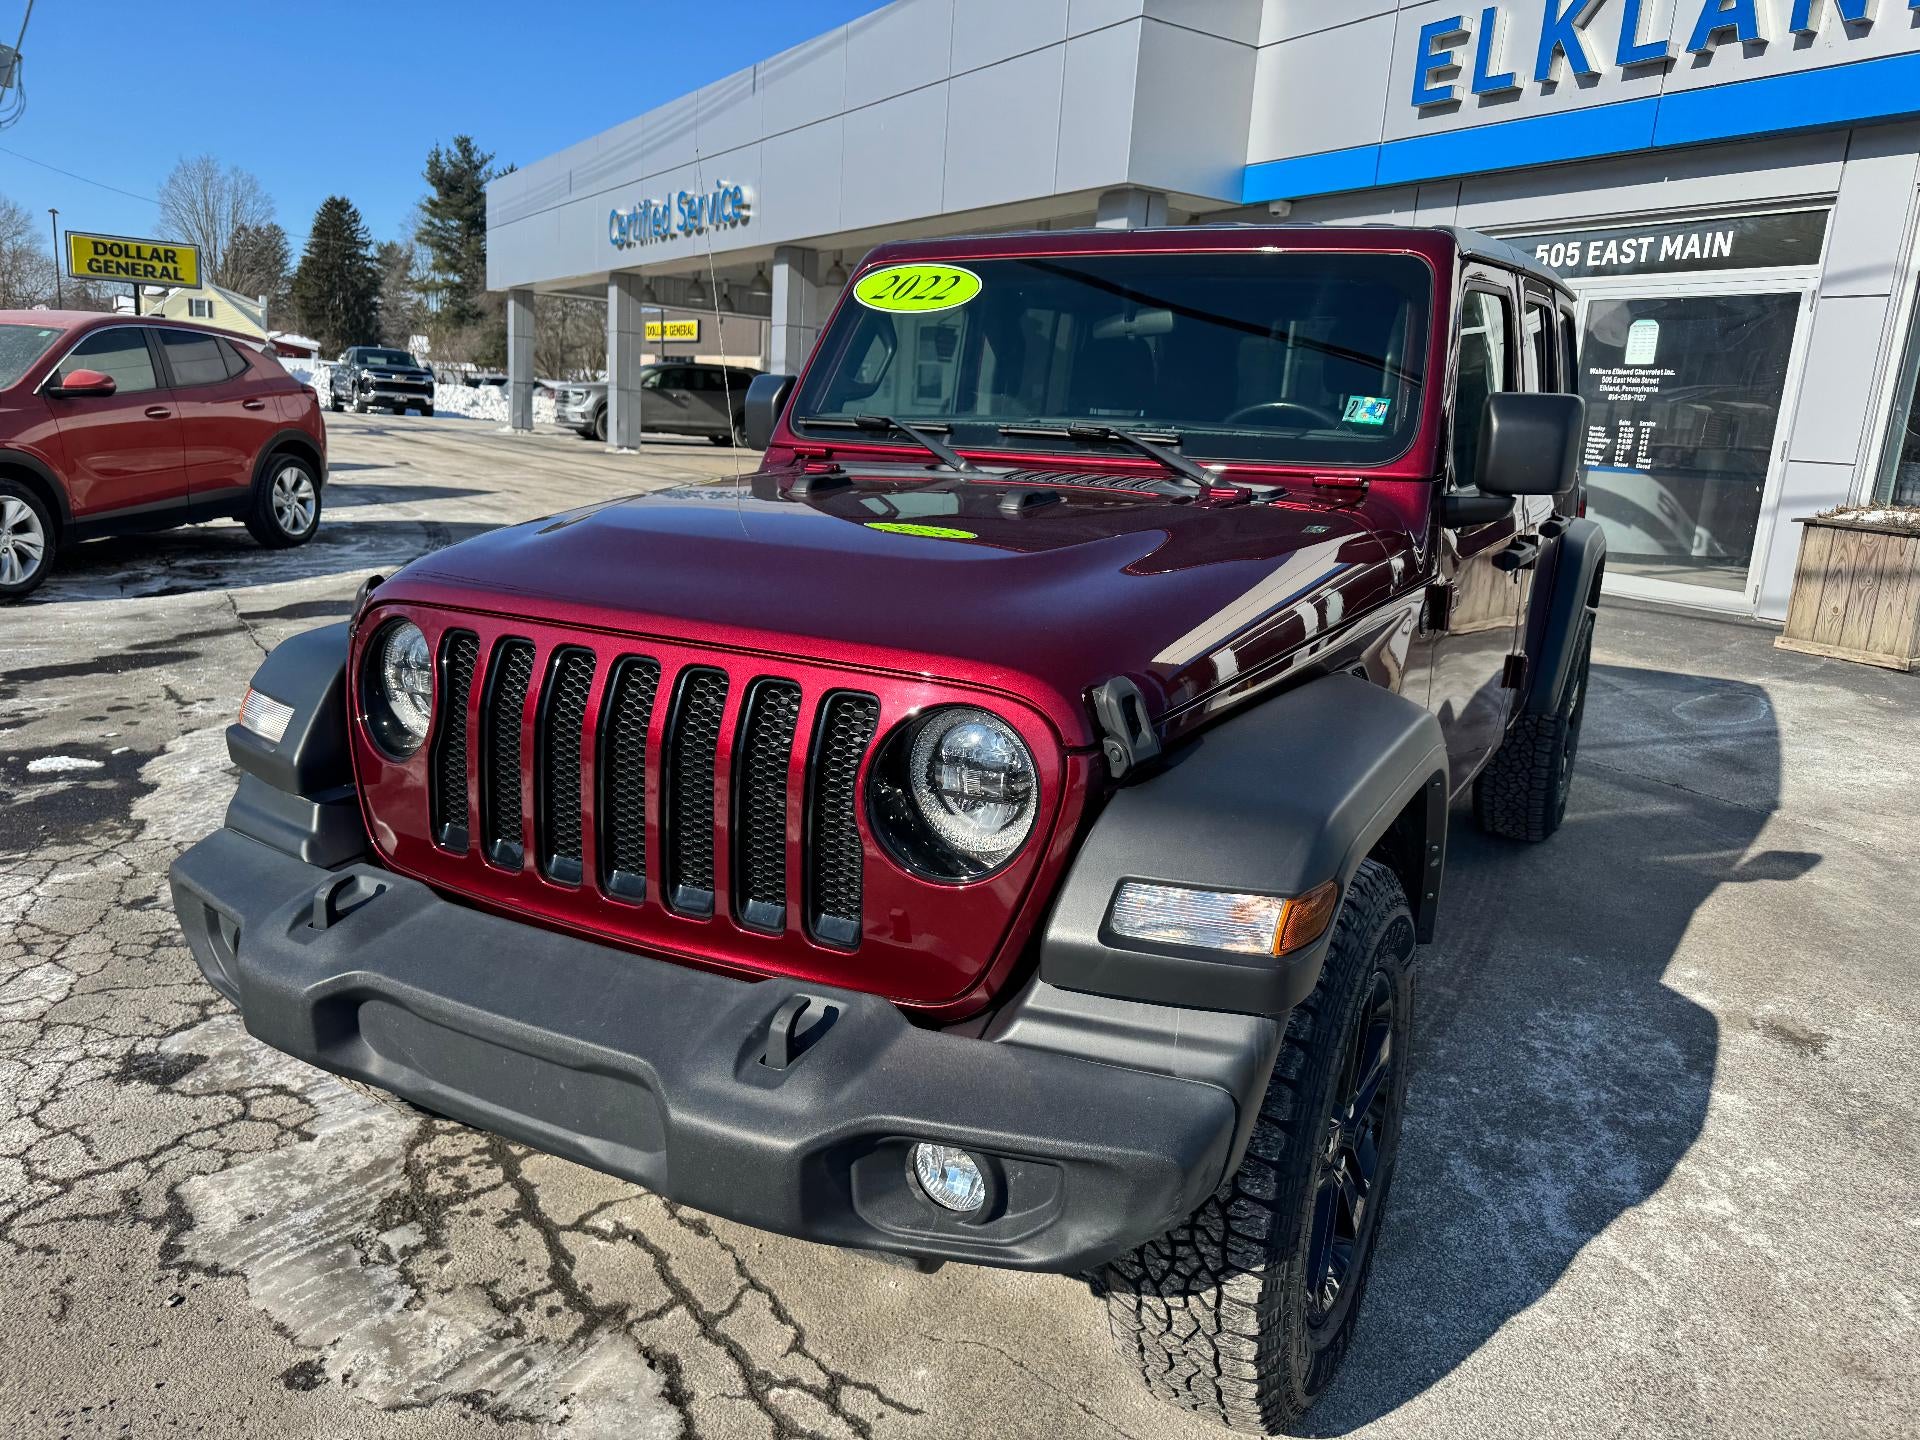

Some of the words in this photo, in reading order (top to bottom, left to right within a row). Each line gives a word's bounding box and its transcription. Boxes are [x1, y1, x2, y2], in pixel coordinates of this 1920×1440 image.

[1412, 0, 1920, 107] ELKLA
[609, 192, 672, 246] Certified
[677, 179, 747, 232] Service
[91, 241, 178, 264] DOLLAR
[1534, 241, 1582, 268] 505
[1586, 236, 1655, 266] EAST
[1658, 231, 1735, 262] MAIN
[87, 257, 185, 281] GENERAL
[869, 275, 961, 300] 2022
[647, 324, 668, 337] DOLLR
[669, 324, 695, 337] GENERAL
[1601, 376, 1613, 384] 505
[1613, 376, 1626, 384] East
[1626, 376, 1640, 384] Main
[1641, 377, 1660, 385] Street
[1612, 367, 1635, 376] Elkland
[1634, 368, 1664, 376] Chevrolet
[1664, 368, 1676, 376] Inc.
[1600, 384, 1621, 392] Elkland,
[1621, 385, 1659, 394] Pennsylvania
[1348, 400, 1359, 418] 2
